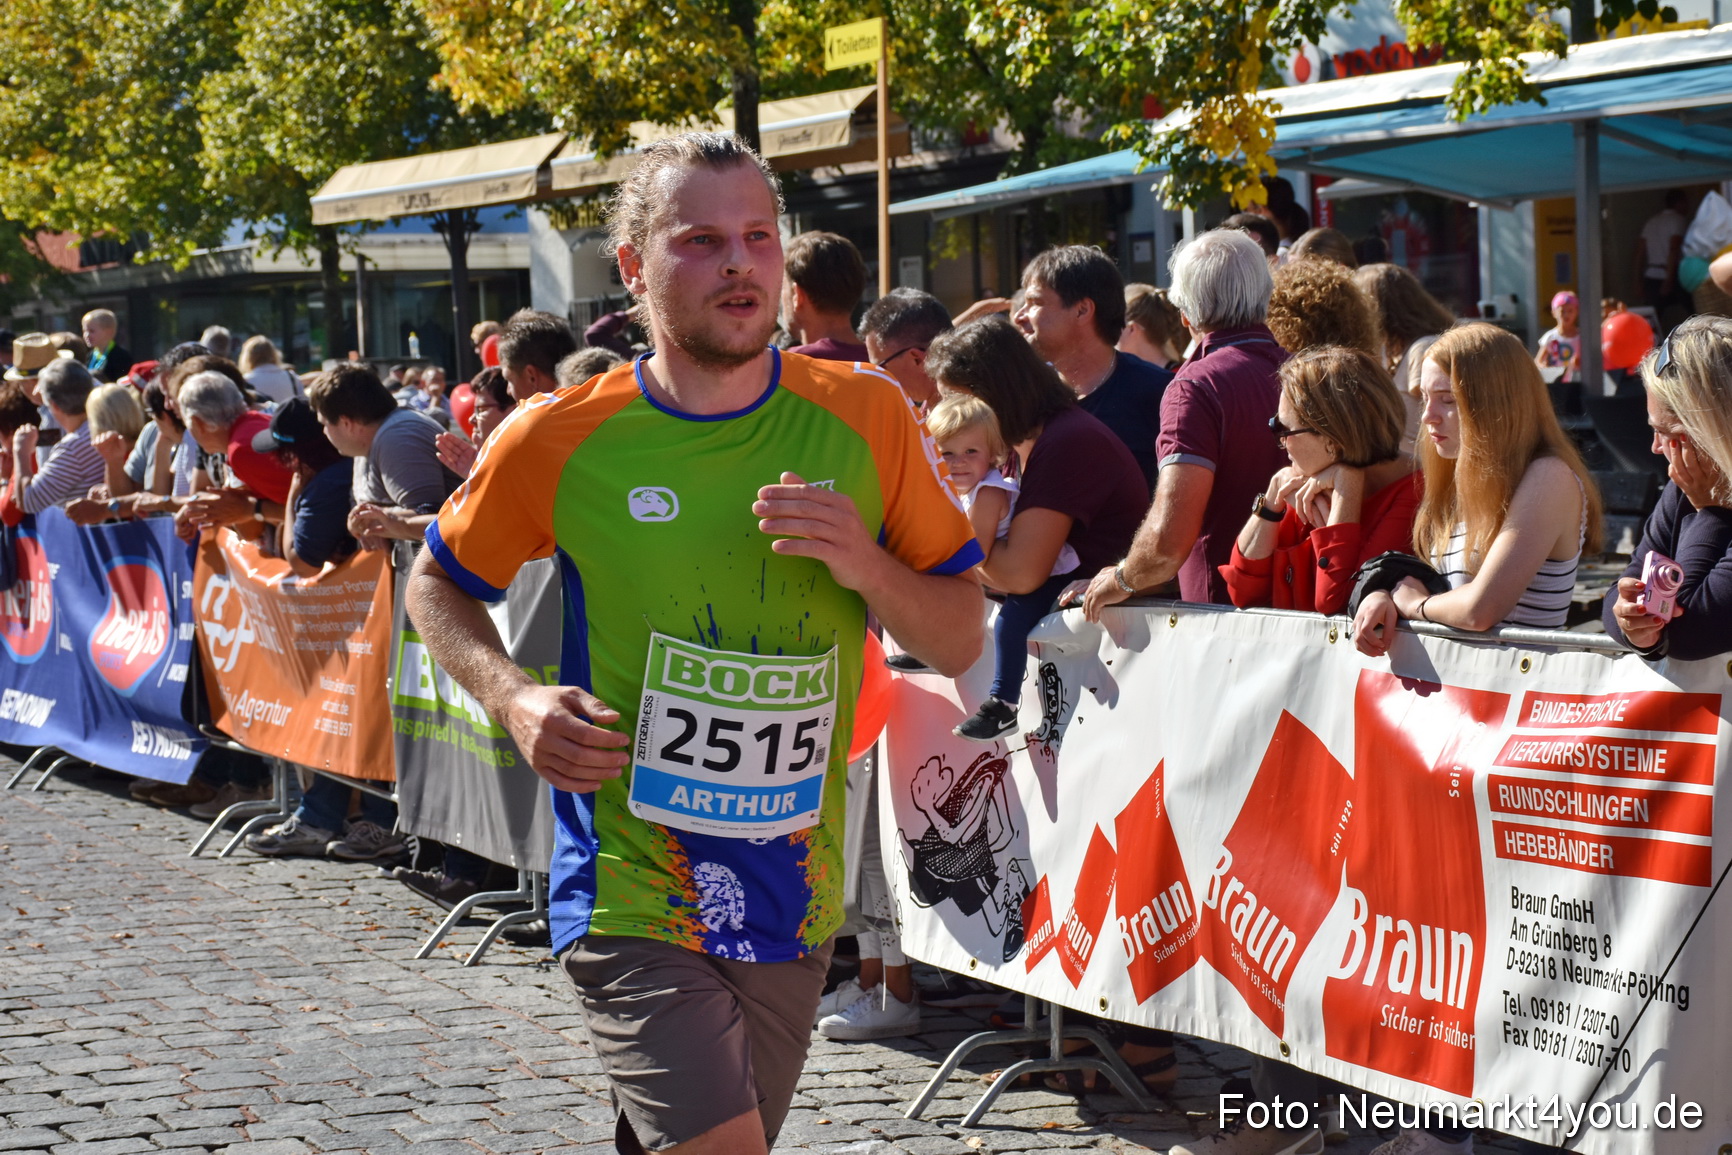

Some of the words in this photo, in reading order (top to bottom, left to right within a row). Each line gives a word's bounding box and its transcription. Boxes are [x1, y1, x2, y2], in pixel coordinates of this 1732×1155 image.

[836, 35, 878, 56] Toiletten
[346, 581, 377, 593] Partner
[662, 647, 829, 704] BOCK
[236, 690, 292, 728] Agentur
[1529, 699, 1630, 724] BINDESTRICKE
[392, 711, 449, 742] nspired
[451, 722, 460, 751] by
[660, 707, 820, 775] 2515
[1507, 741, 1667, 774] VERZURRSYSTEME
[668, 784, 797, 817] ARTHUR
[1498, 784, 1649, 823] RUNDSCHLINGEN
[1330, 832, 1342, 856] Seit
[1338, 800, 1353, 831] 1929
[1504, 830, 1614, 869] HEBEBÄNDER
[1117, 880, 1193, 967] Braun
[1203, 845, 1296, 983] Braun
[1511, 885, 1547, 916] Braun
[1551, 893, 1595, 924] GmbH
[1022, 920, 1052, 959] Braun
[1154, 940, 1178, 964] Sicher
[1177, 934, 1187, 950] ist
[1328, 886, 1473, 1010] Braun
[1510, 916, 1528, 943] Am
[1532, 921, 1598, 962] Grünberg
[1603, 933, 1612, 959] 8
[1231, 943, 1251, 977] Sicher
[1251, 968, 1261, 987] ist
[1261, 983, 1285, 1012] sicher
[1506, 947, 1557, 981] D-92318
[1562, 957, 1690, 1012] Neumarkt-Pölling
[1380, 1003, 1425, 1036] Sicher
[1429, 1016, 1444, 1041] ist
[1445, 1021, 1475, 1050] sicher
[1503, 990, 1527, 1018] Tel.
[1531, 996, 1571, 1027] 09181
[1581, 1007, 1620, 1040] 2307-0
[1503, 1020, 1529, 1048] Fax
[1533, 1026, 1568, 1058] 09181
[1576, 1038, 1631, 1074] 2307-70
